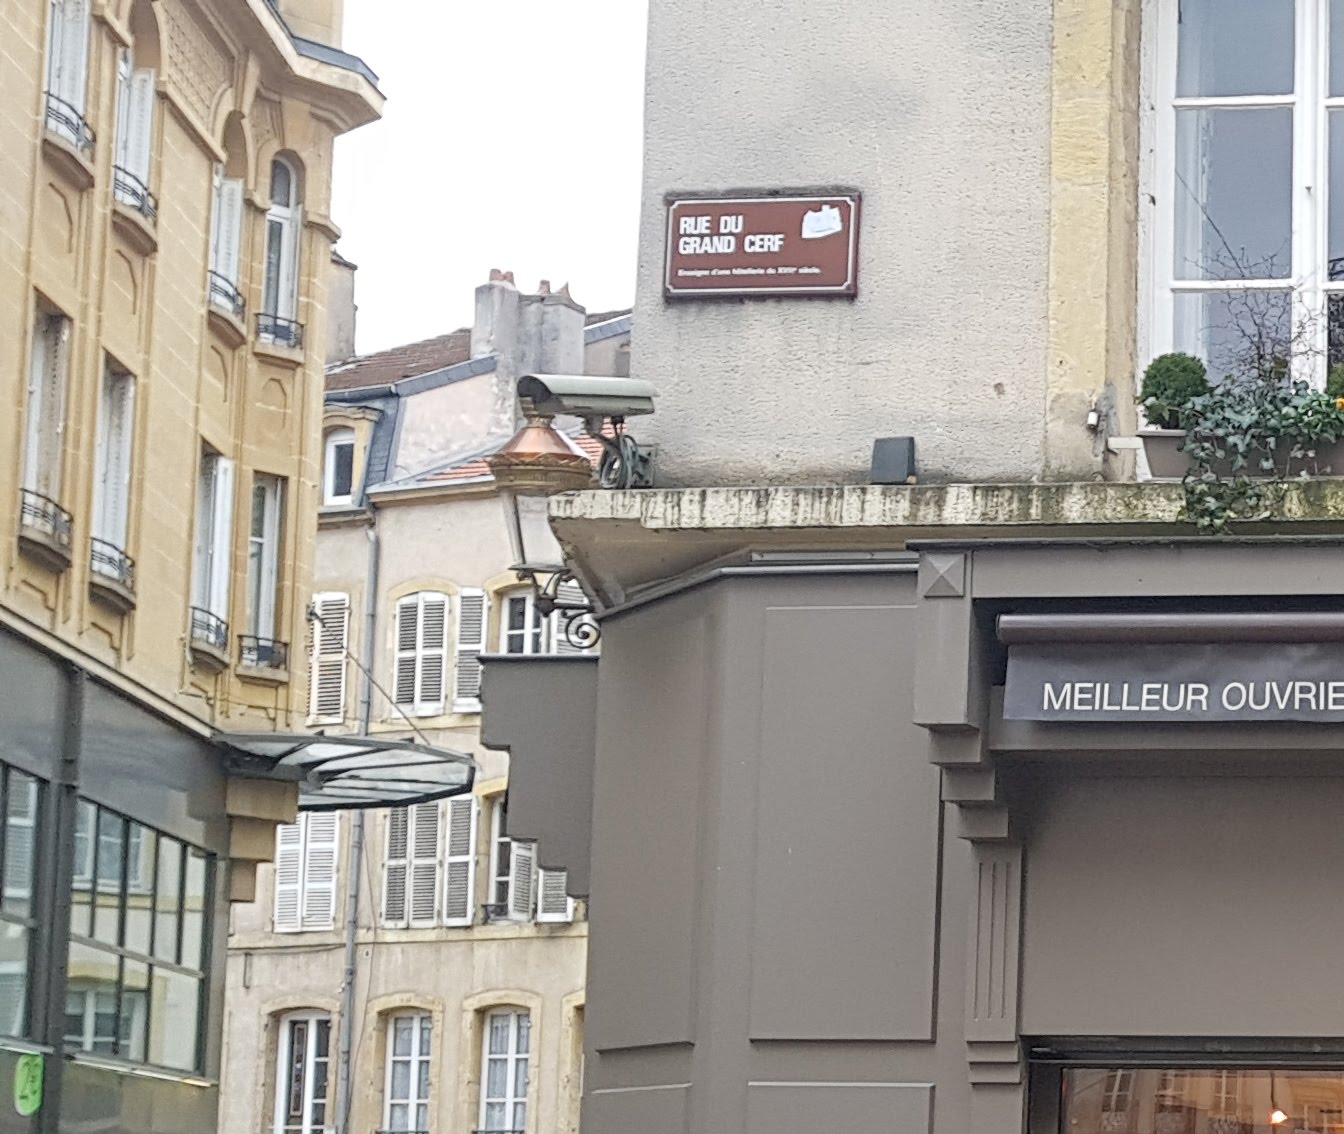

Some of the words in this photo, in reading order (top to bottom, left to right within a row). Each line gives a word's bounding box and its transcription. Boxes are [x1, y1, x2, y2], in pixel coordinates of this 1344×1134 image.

[679, 216, 712, 235] RUE
[719, 215, 744, 233] DU
[678, 236, 736, 255] GRAND
[744, 234, 785, 253] CERF
[1042, 682, 1209, 711] MEILLEUR
